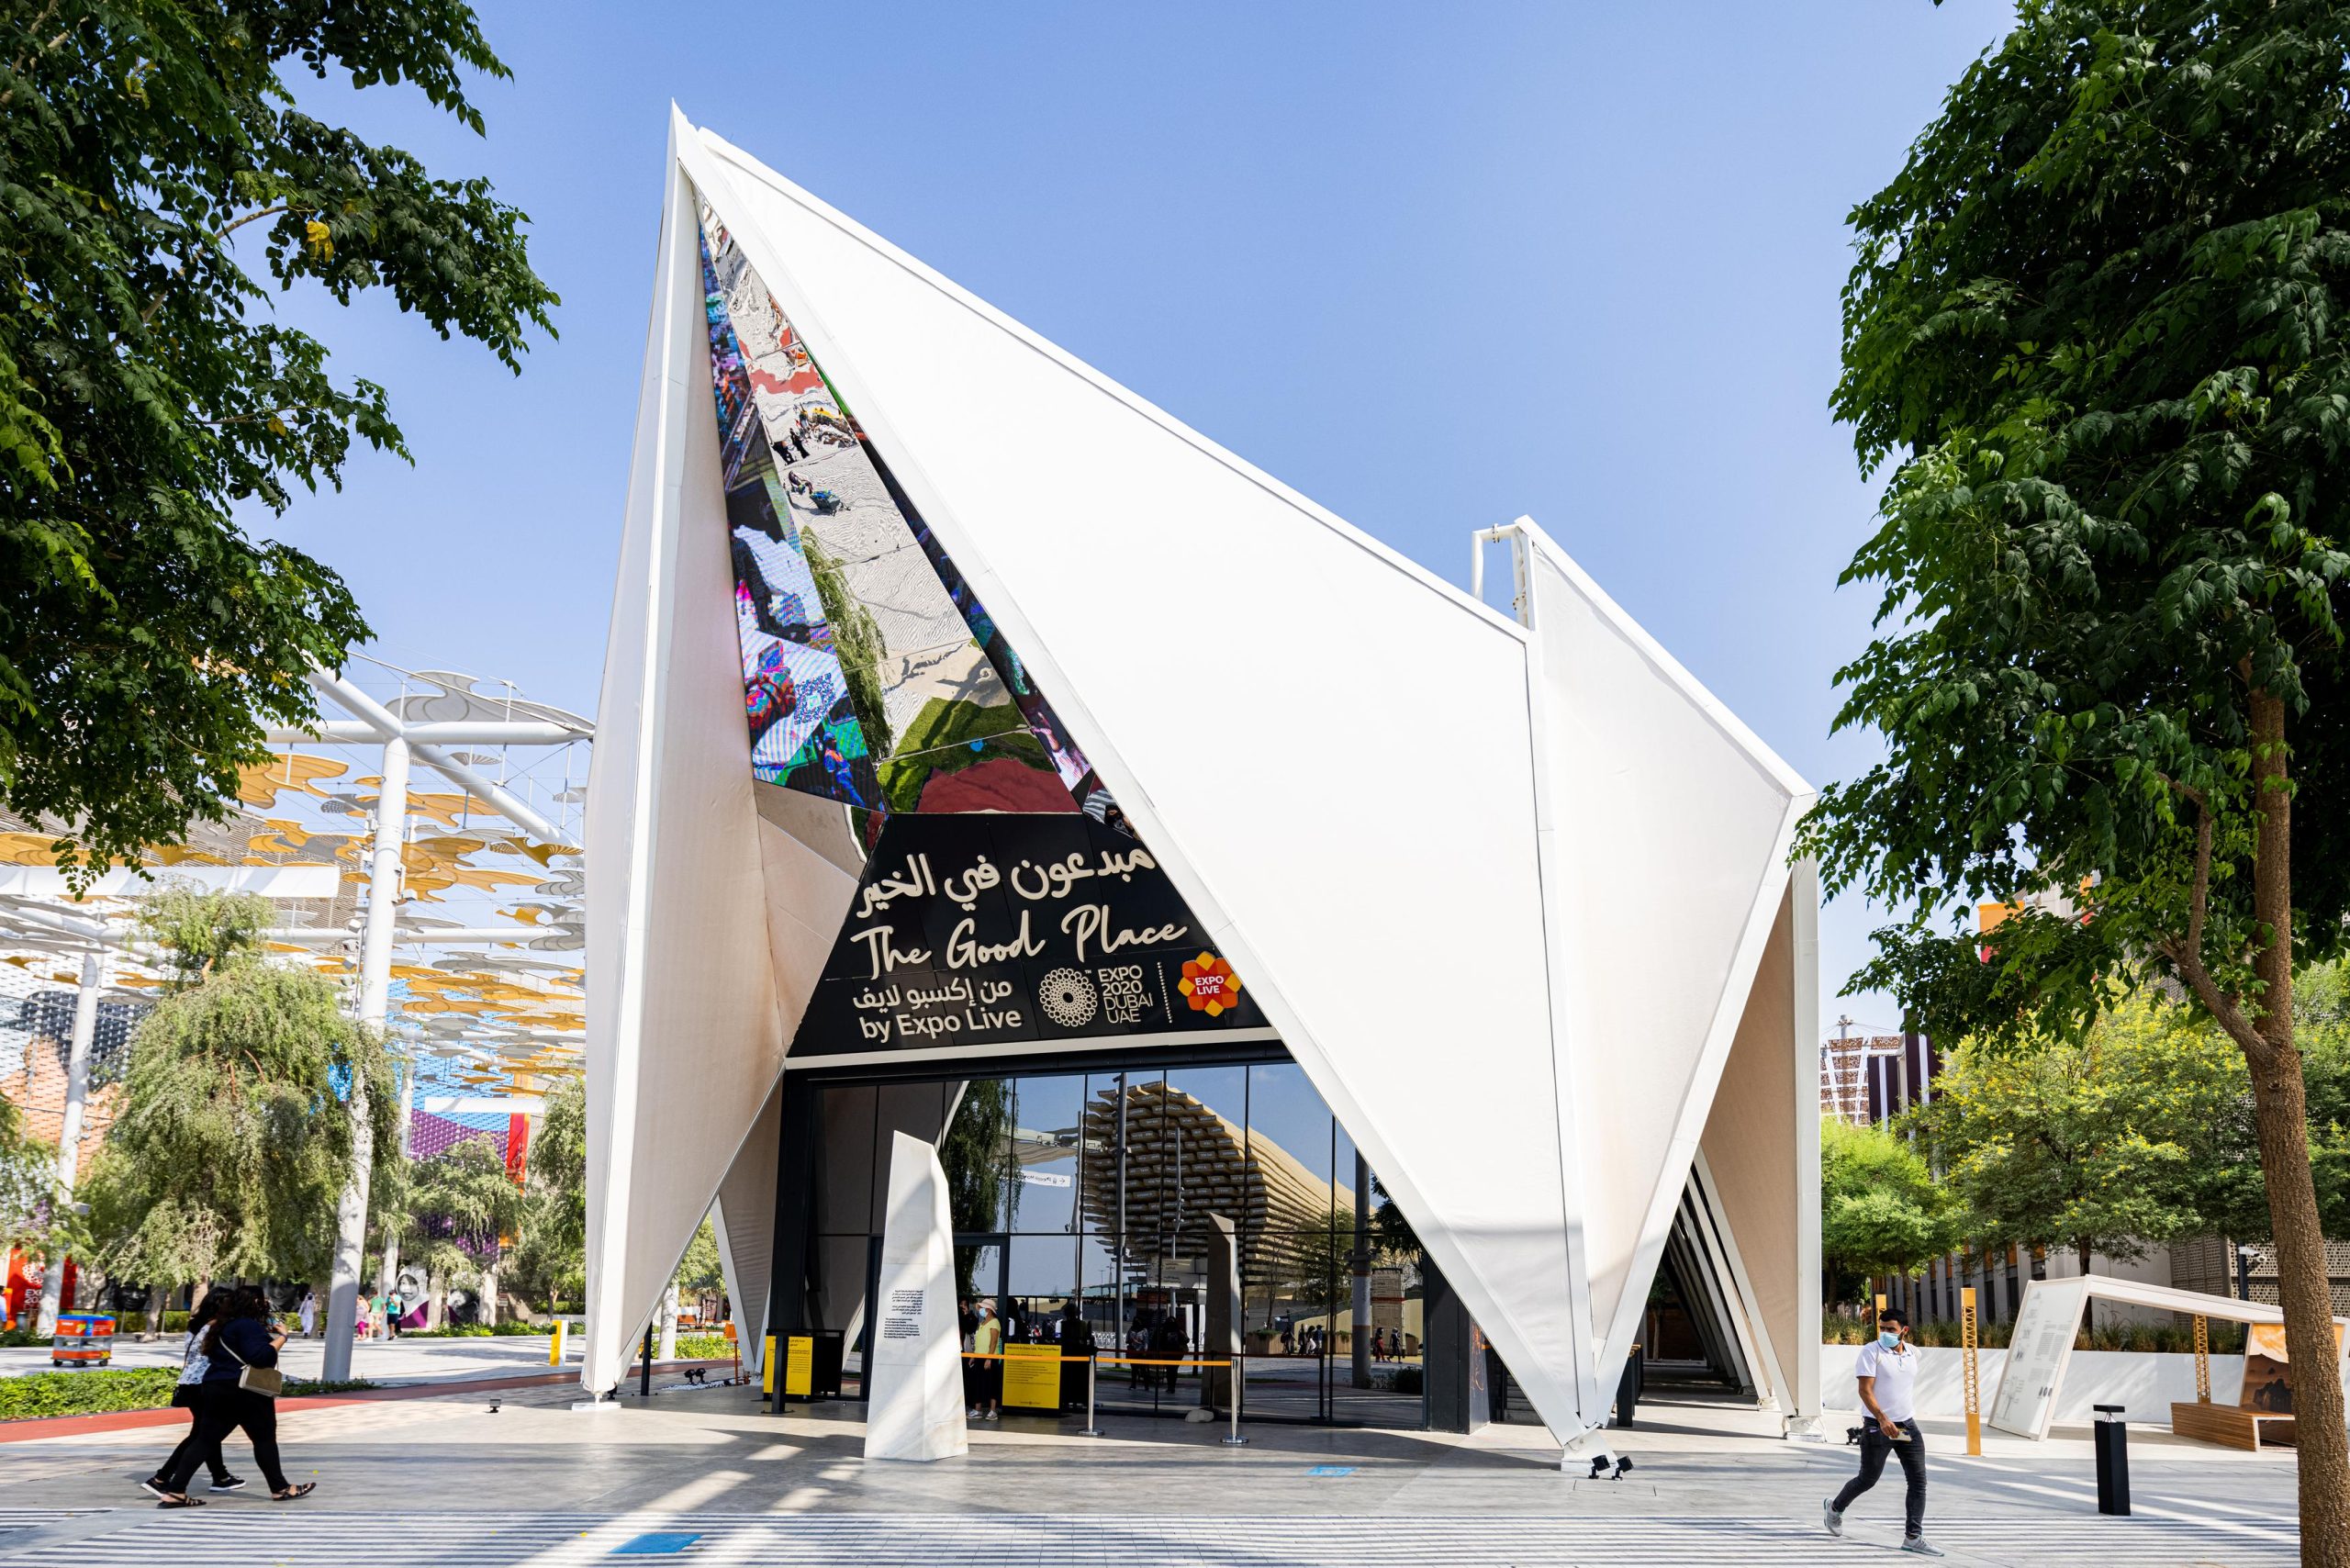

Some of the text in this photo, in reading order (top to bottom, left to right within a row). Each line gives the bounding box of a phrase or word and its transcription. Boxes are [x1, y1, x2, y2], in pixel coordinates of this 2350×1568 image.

[856, 849, 1156, 919] مبدعون في الخير
[850, 904, 1188, 980] The Good Place
[1097, 965, 1143, 982] EXPO
[1194, 975, 1225, 986] EXPO
[852, 977, 1013, 1014] من إكسبو لايف
[1102, 980, 1143, 997] 2020
[1196, 985, 1221, 996] LIVE
[1103, 992, 1154, 1011] DUBAI
[858, 1006, 1022, 1044] by Expo Live
[1106, 1008, 1141, 1024] UAE
